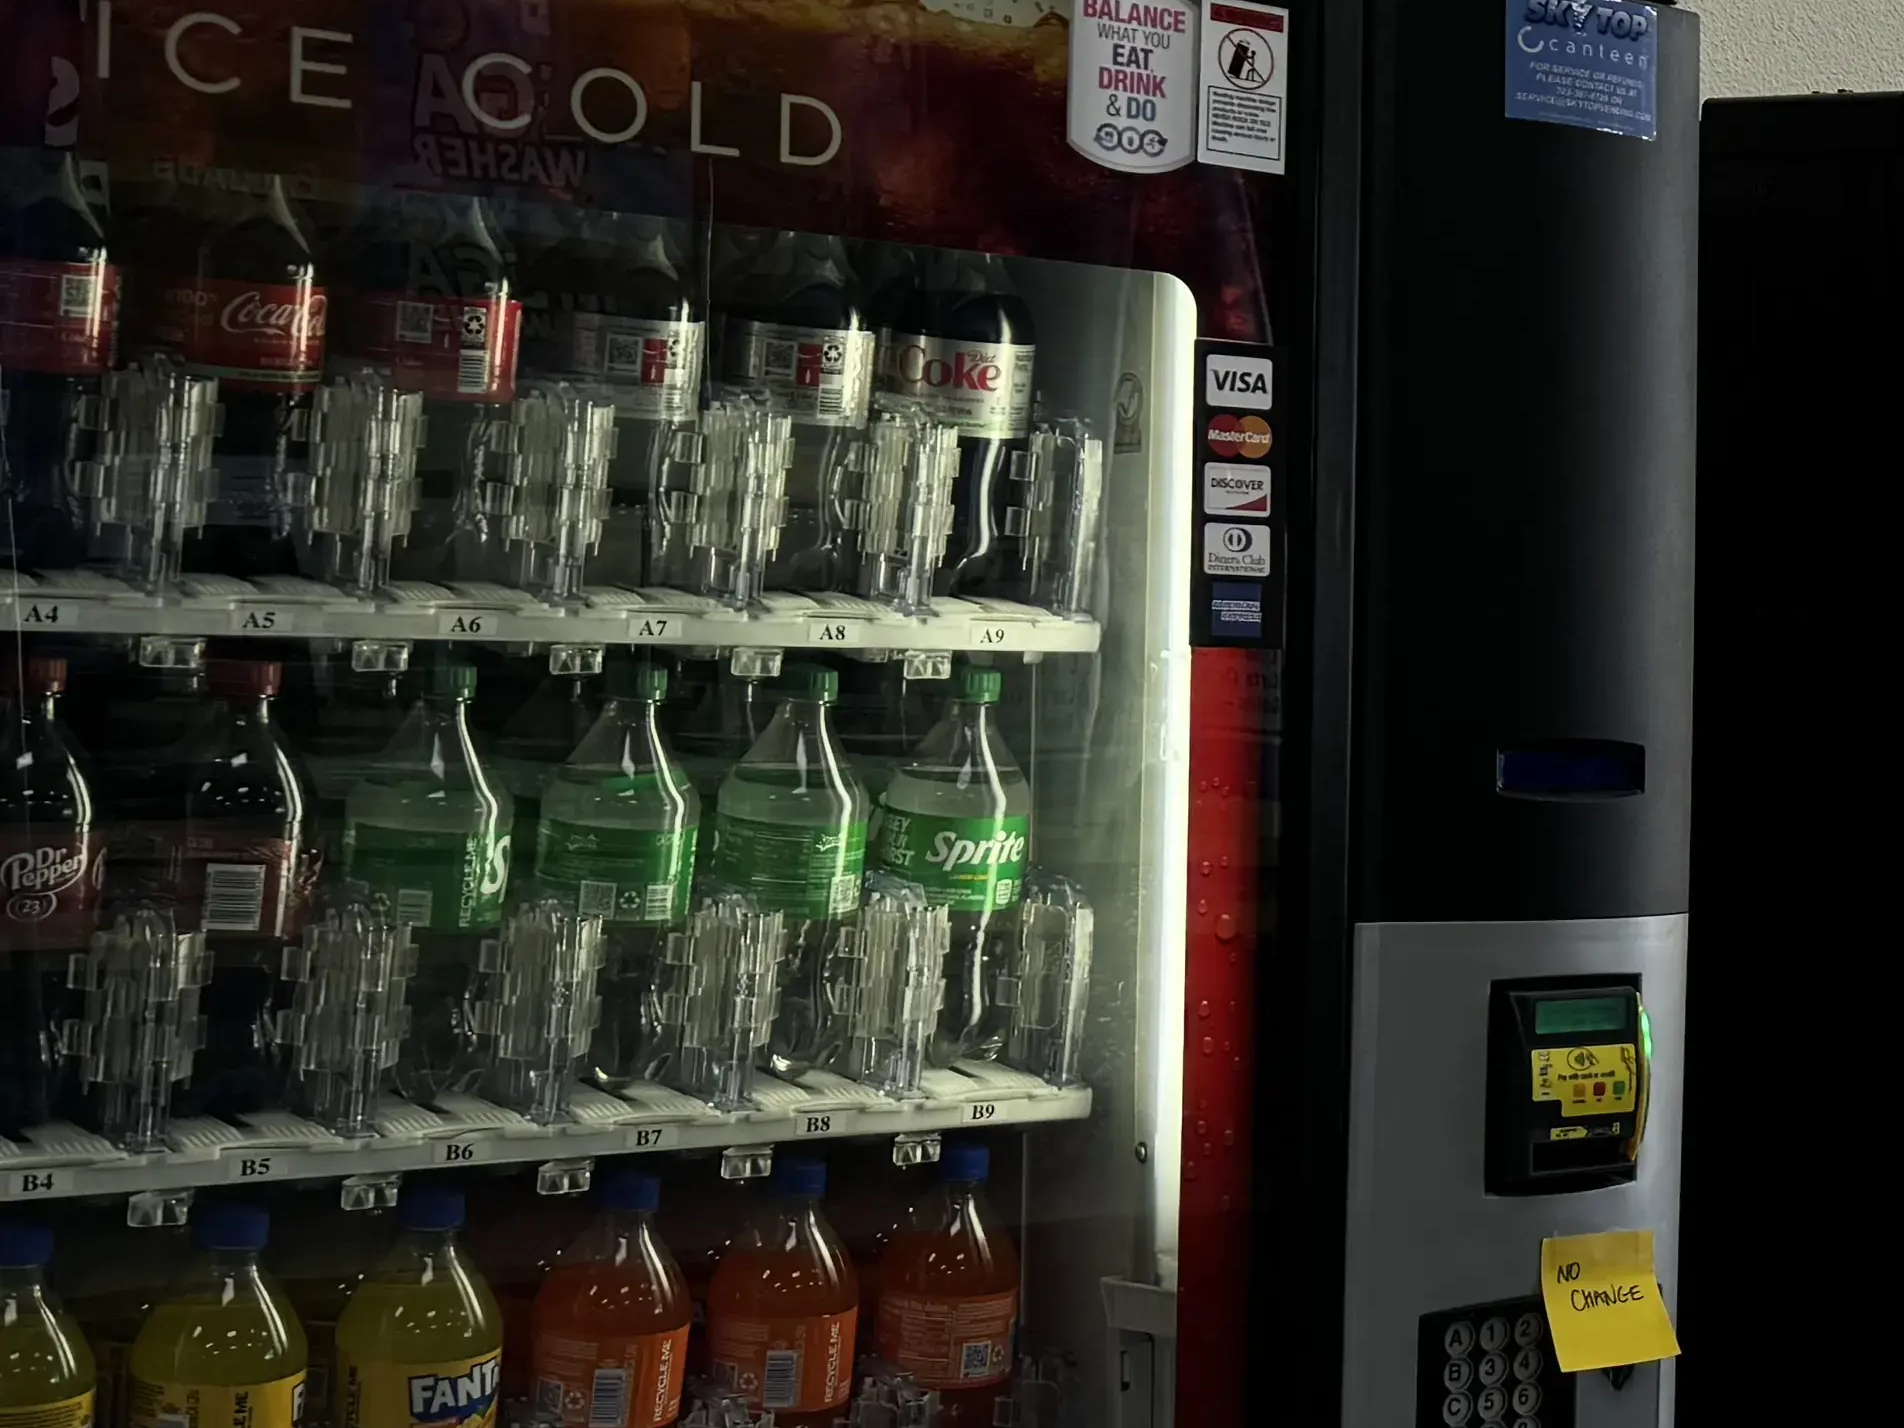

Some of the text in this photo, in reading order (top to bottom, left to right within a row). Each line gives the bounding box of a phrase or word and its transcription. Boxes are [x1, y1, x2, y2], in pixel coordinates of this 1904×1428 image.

[1097, 23, 1170, 49] WHAT YOU
[1597, 7, 1648, 42] TOP
[1549, 39, 1648, 70] canteen
[1099, 66, 1167, 99] DRINK
[462, 52, 842, 167] COLD
[1106, 94, 1156, 121] & DO
[901, 346, 1001, 392] Coke
[1210, 369, 1268, 394] VISA
[1208, 429, 1270, 444] MasterCard
[1211, 477, 1263, 491] DISCOVER
[25, 605, 1005, 645] A4 A5 A6 A7 A8 A9
[36, 846, 68, 869] Dr
[925, 830, 1025, 870] Sprite
[10, 854, 85, 892] Pepper
[22, 899, 43, 914] 23
[22, 1103, 995, 1194] B4 B5 B6 B7 B8 B9
[1557, 1262, 1581, 1284] NO
[1570, 1285, 1645, 1312] CHANGE
[1450, 1322, 1531, 1347] A 1 2
[1449, 1355, 1530, 1382] B 3 4
[410, 1358, 499, 1417] FANT
[1448, 1389, 1529, 1415] C 5 6
